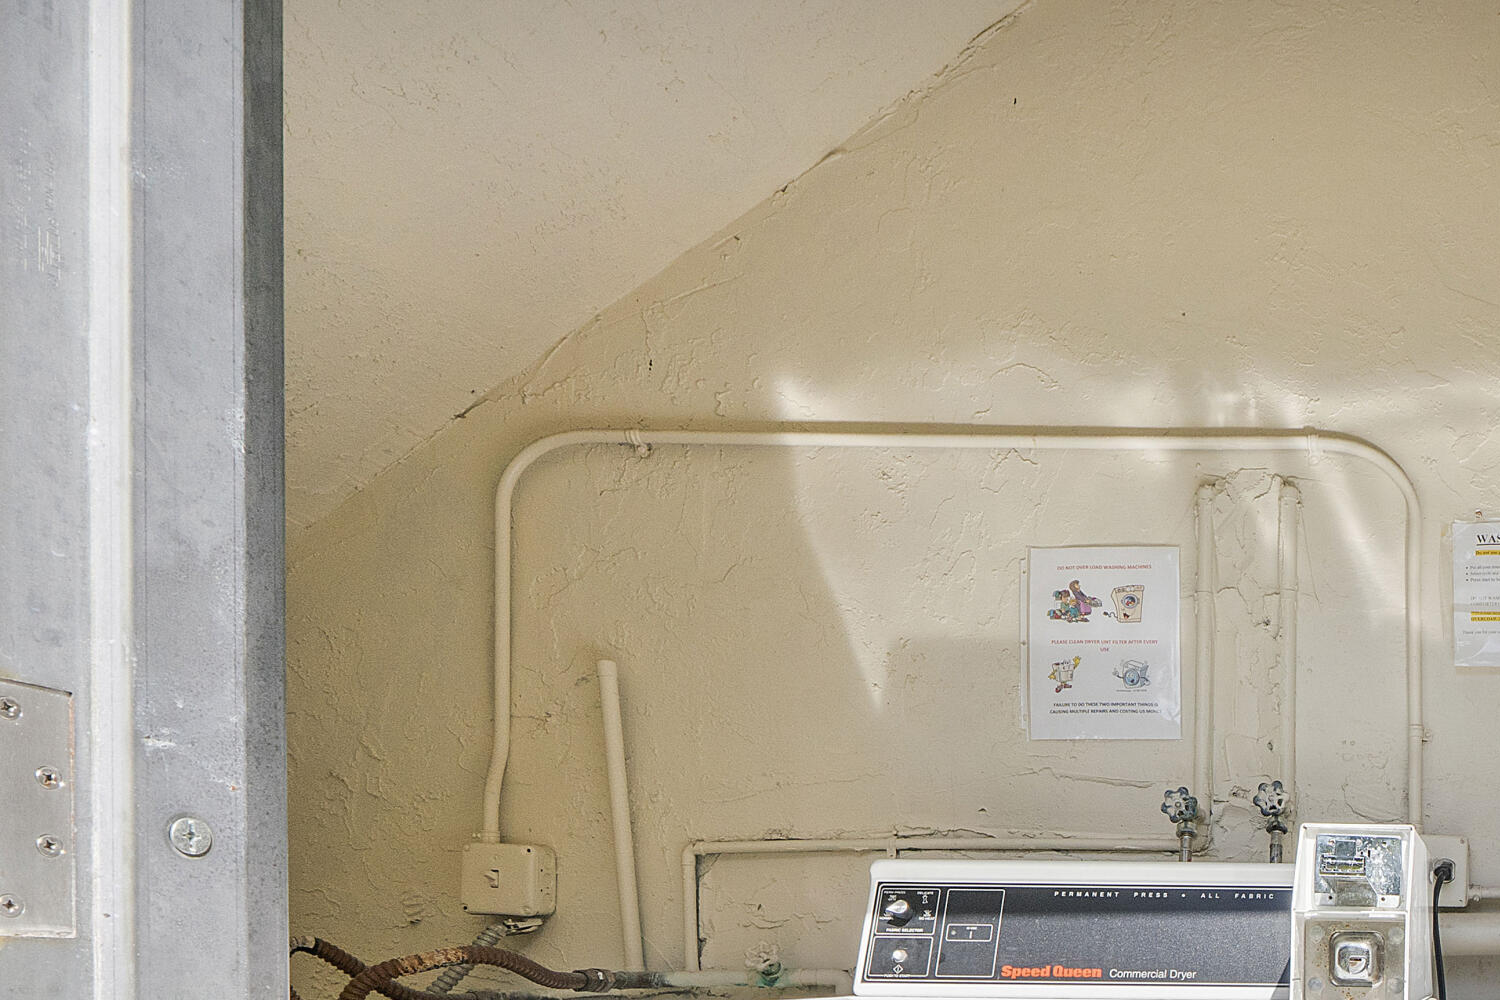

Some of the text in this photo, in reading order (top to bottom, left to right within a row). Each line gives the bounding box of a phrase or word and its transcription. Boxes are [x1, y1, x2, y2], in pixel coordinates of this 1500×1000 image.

[1001, 965, 1197, 979] Speed Queen Commercial Dryer
